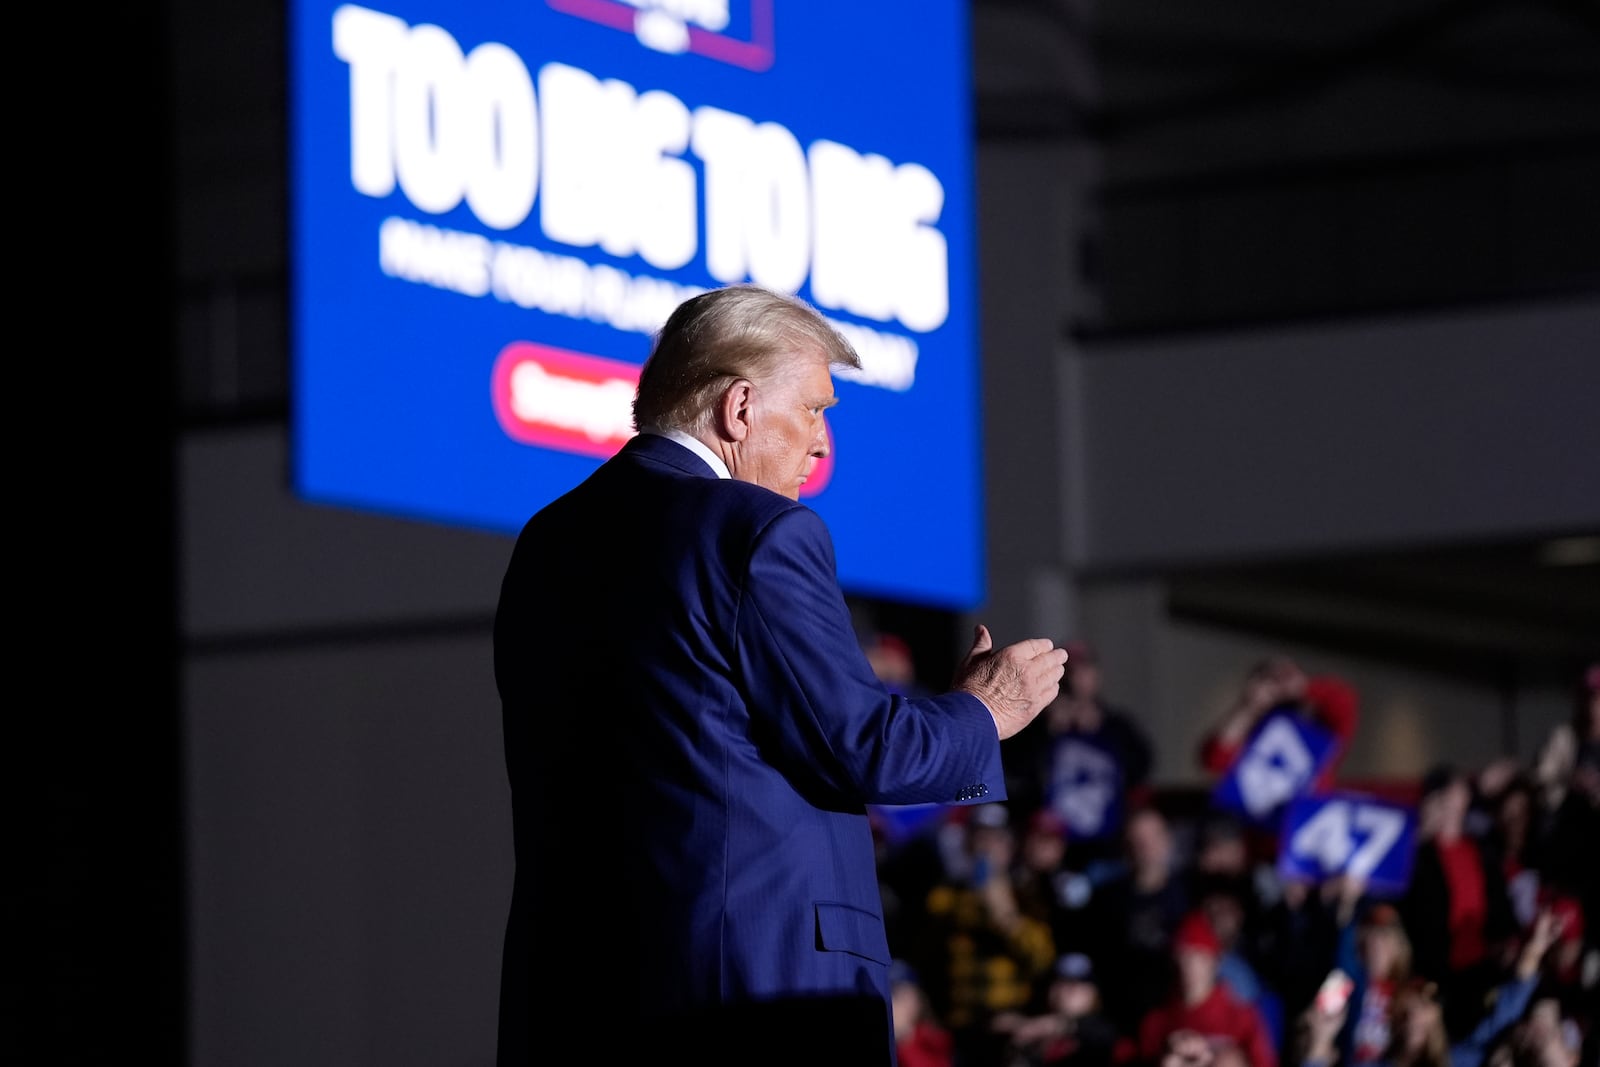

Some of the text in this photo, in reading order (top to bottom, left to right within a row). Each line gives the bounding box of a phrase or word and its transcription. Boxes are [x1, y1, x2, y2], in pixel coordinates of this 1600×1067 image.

[333, 4, 539, 229] TOO
[539, 62, 697, 269] BIG
[692, 106, 810, 294] TO
[1291, 799, 1406, 883] 47
